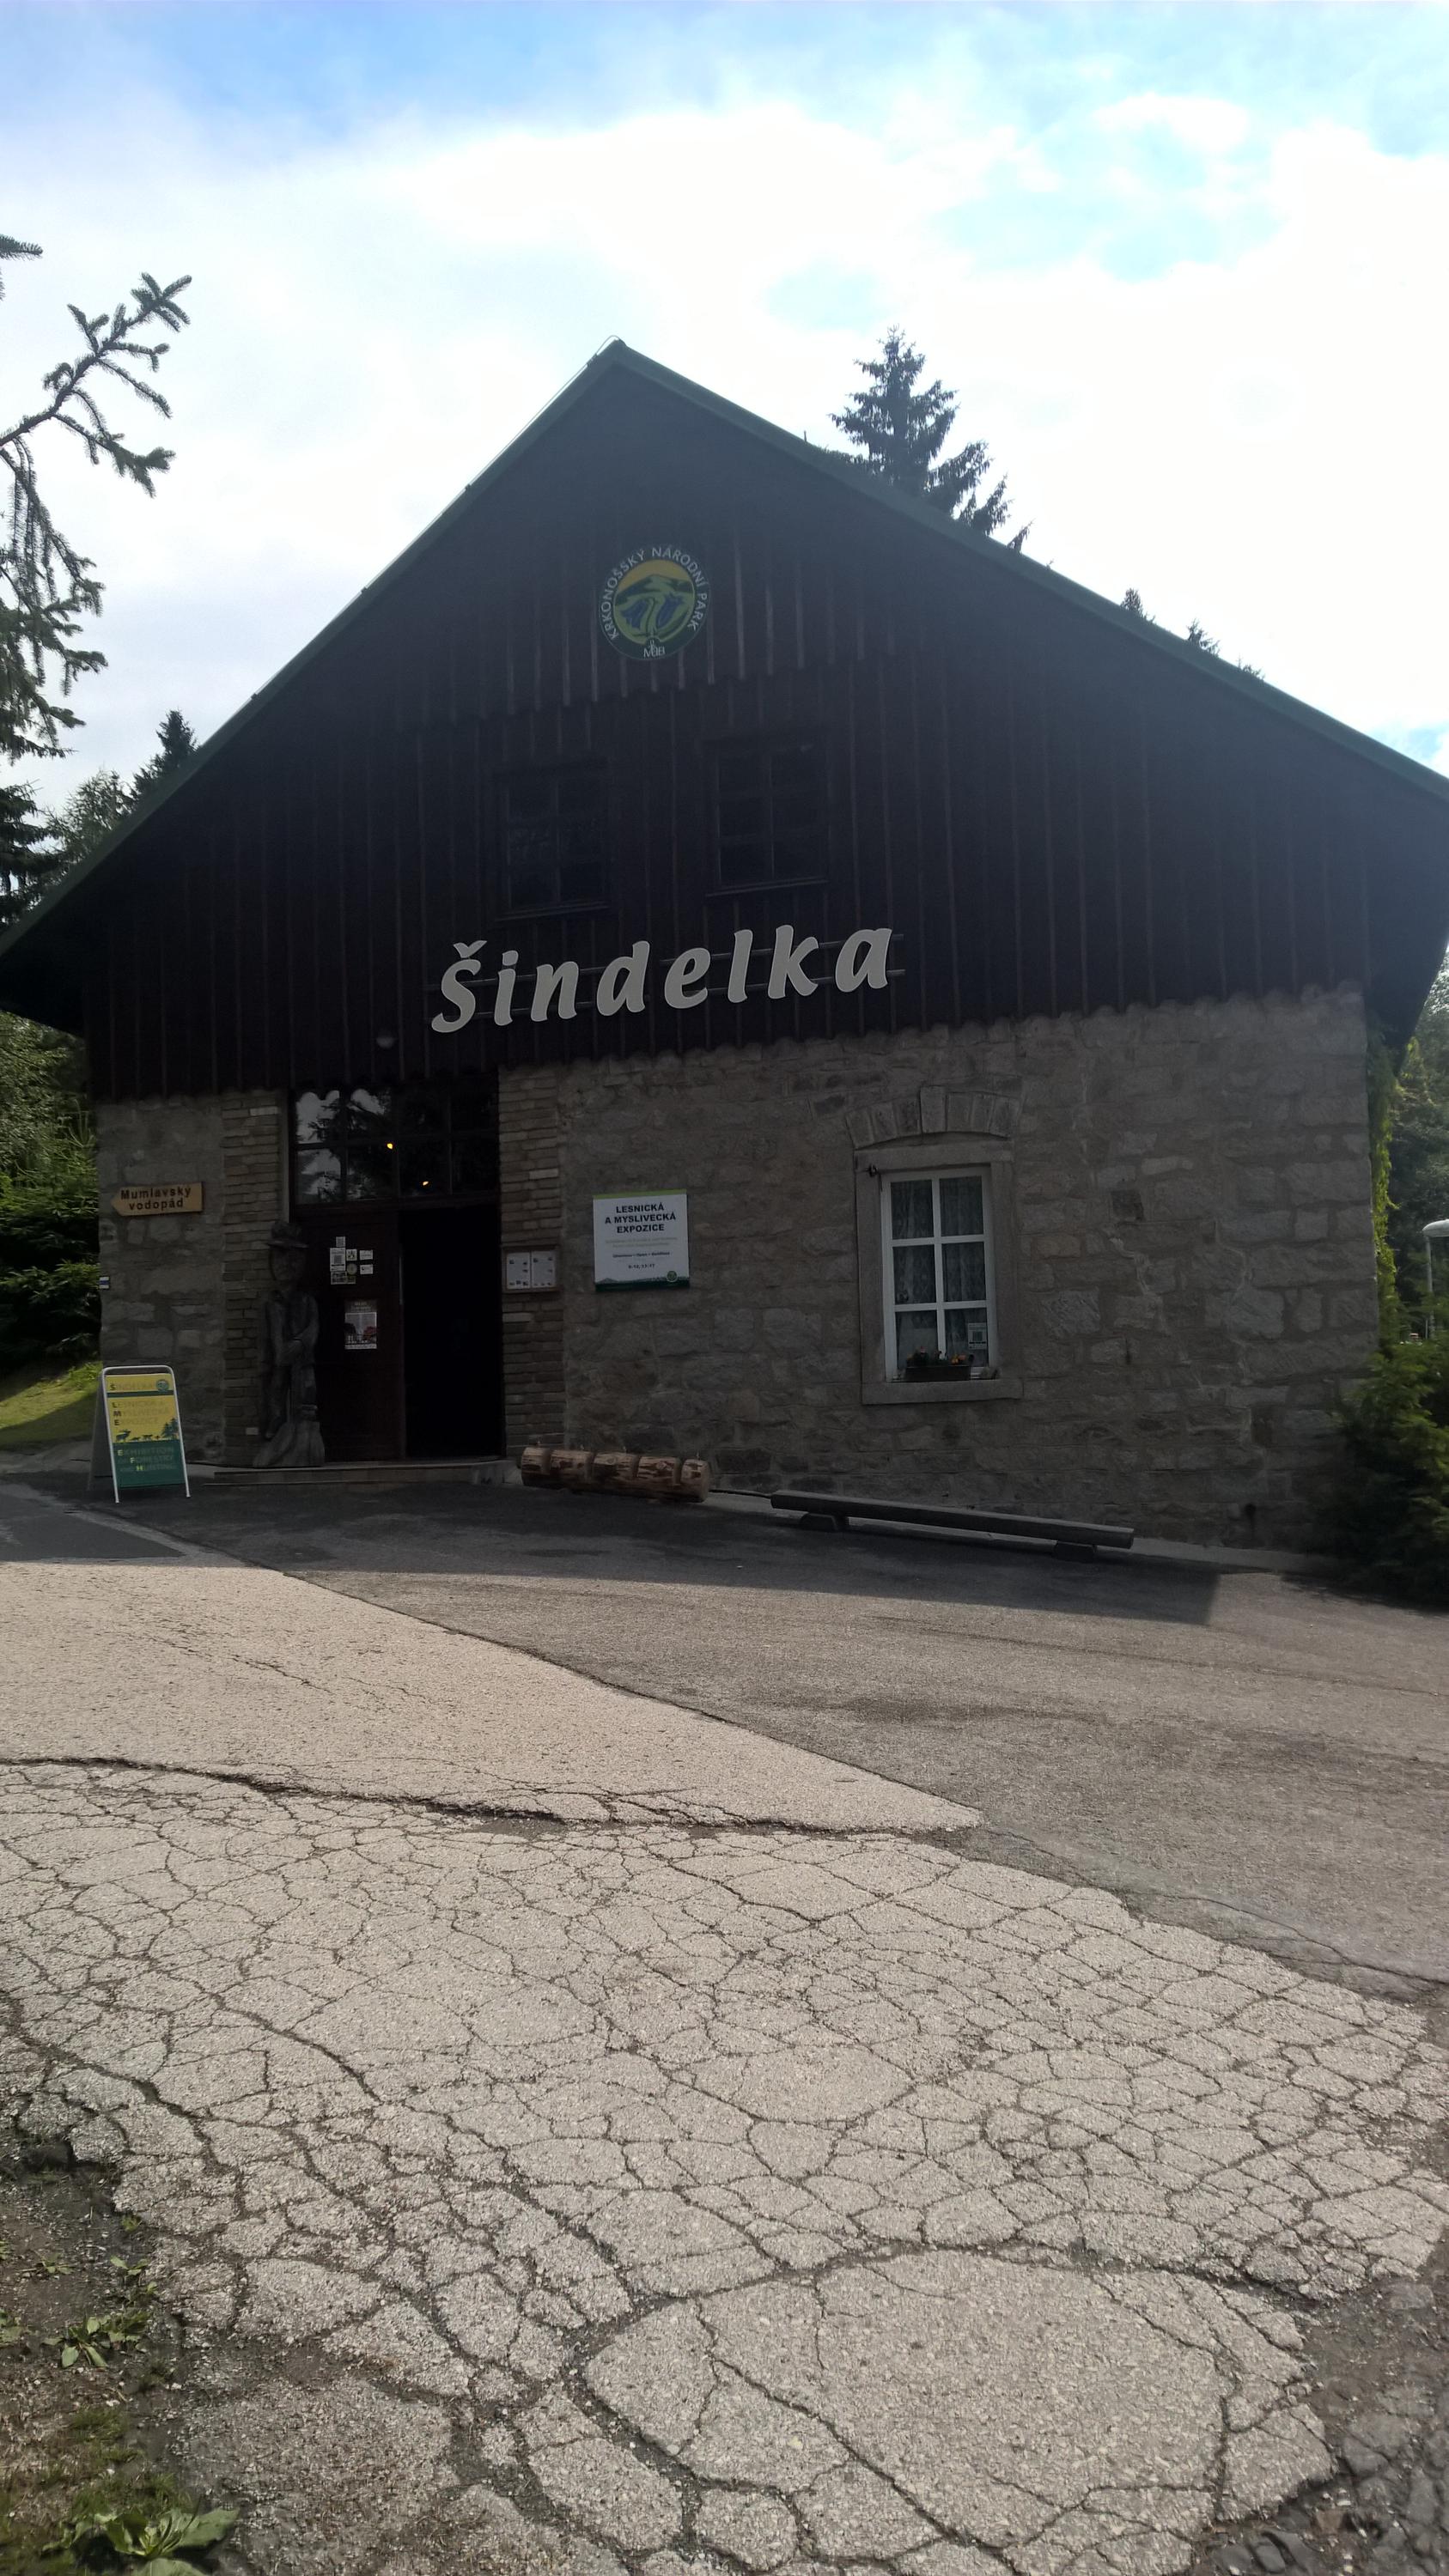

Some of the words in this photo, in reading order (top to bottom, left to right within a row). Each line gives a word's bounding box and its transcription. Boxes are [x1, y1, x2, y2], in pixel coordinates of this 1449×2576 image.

[601, 549, 645, 640] KRKONOŠSKÝ
[651, 544, 709, 587] NÁRODNÍ
[687, 592, 708, 631] PARK
[431, 924, 893, 1034] Šindelka
[129, 1198, 184, 1211] vodopád
[616, 1202, 665, 1213] LESNICKÁ
[614, 1212, 677, 1224] MYSLIVECKÁ
[617, 1224, 665, 1234] EXPOZICE
